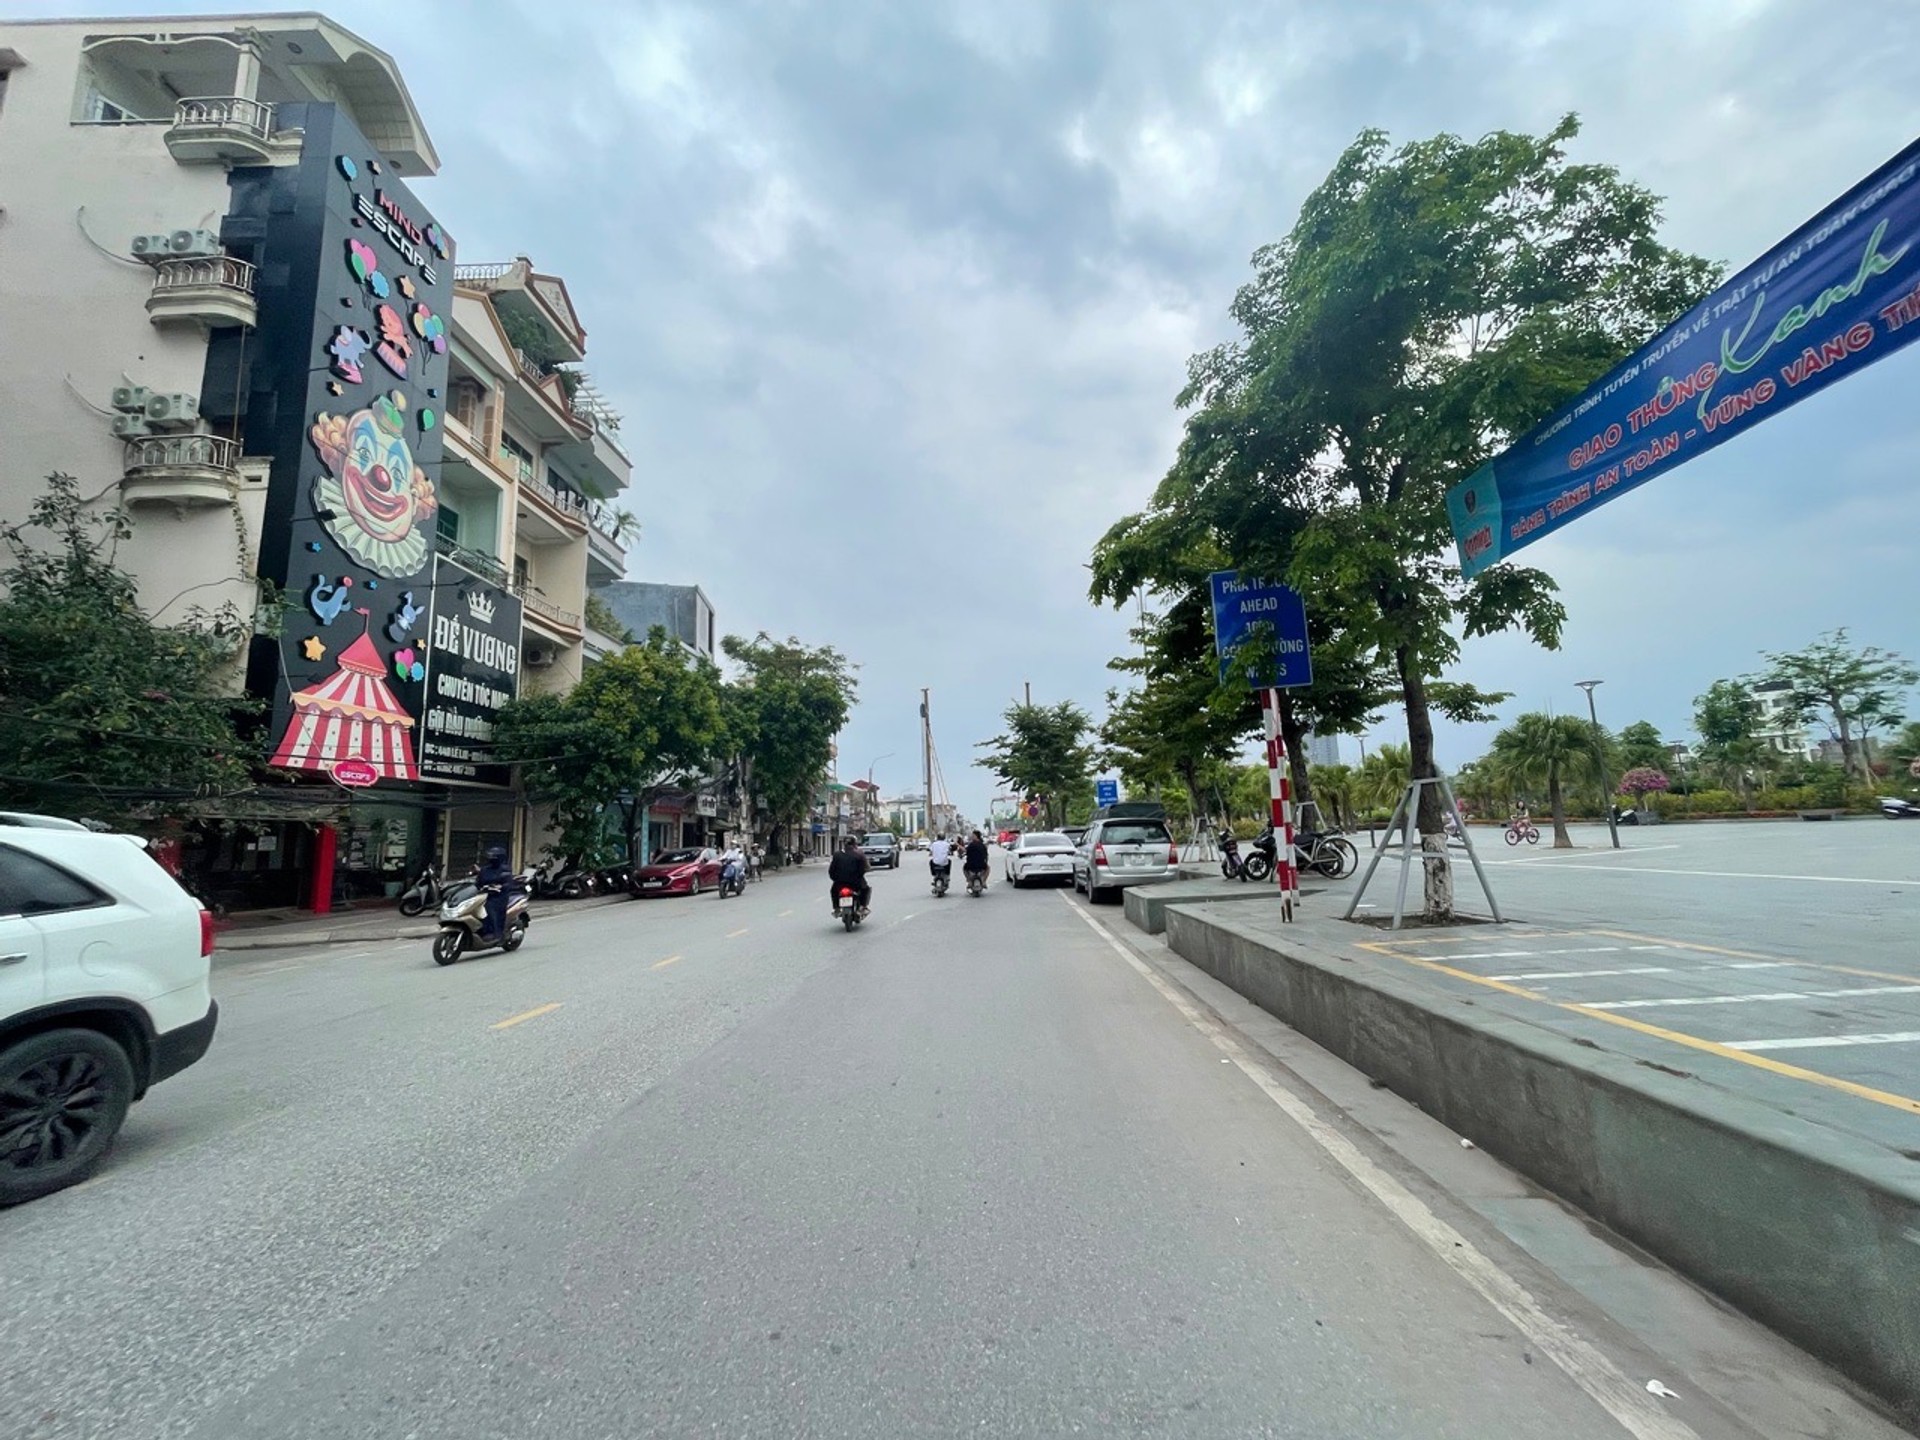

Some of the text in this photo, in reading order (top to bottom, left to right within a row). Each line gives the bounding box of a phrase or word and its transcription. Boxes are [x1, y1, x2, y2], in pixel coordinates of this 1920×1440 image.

[358, 194, 436, 285] ESCAPE
[378, 190, 423, 246] MIND
[1573, 391, 1602, 419] TRÌNH
[1603, 364, 1640, 397] TUYÊN
[1641, 327, 1690, 370] TRUYỀN
[1692, 306, 1710, 333] VỀ
[1712, 284, 1749, 319] TRẬT
[1753, 259, 1777, 289] TỰ
[1777, 246, 1802, 273] AN
[1805, 203, 1858, 251] TOÀN
[1568, 217, 1912, 471] GIAO THÔNG Xanh
[1510, 508, 1546, 541] HÀNH
[1546, 481, 1591, 520] TRÌNH
[1594, 465, 1620, 495] AN
[1623, 431, 1680, 478] TOÀN
[1684, 428, 1697, 440] -
[1701, 377, 1777, 433] VỮNG
[1781, 320, 1876, 388] VÀNG
[1241, 597, 1278, 614] AHEAD
[434, 613, 517, 675] ĐẾ VƯƠNG
[427, 705, 445, 736] GỘI
[437, 673, 474, 703] CHUYÊN
[475, 682, 490, 708] TÓC
